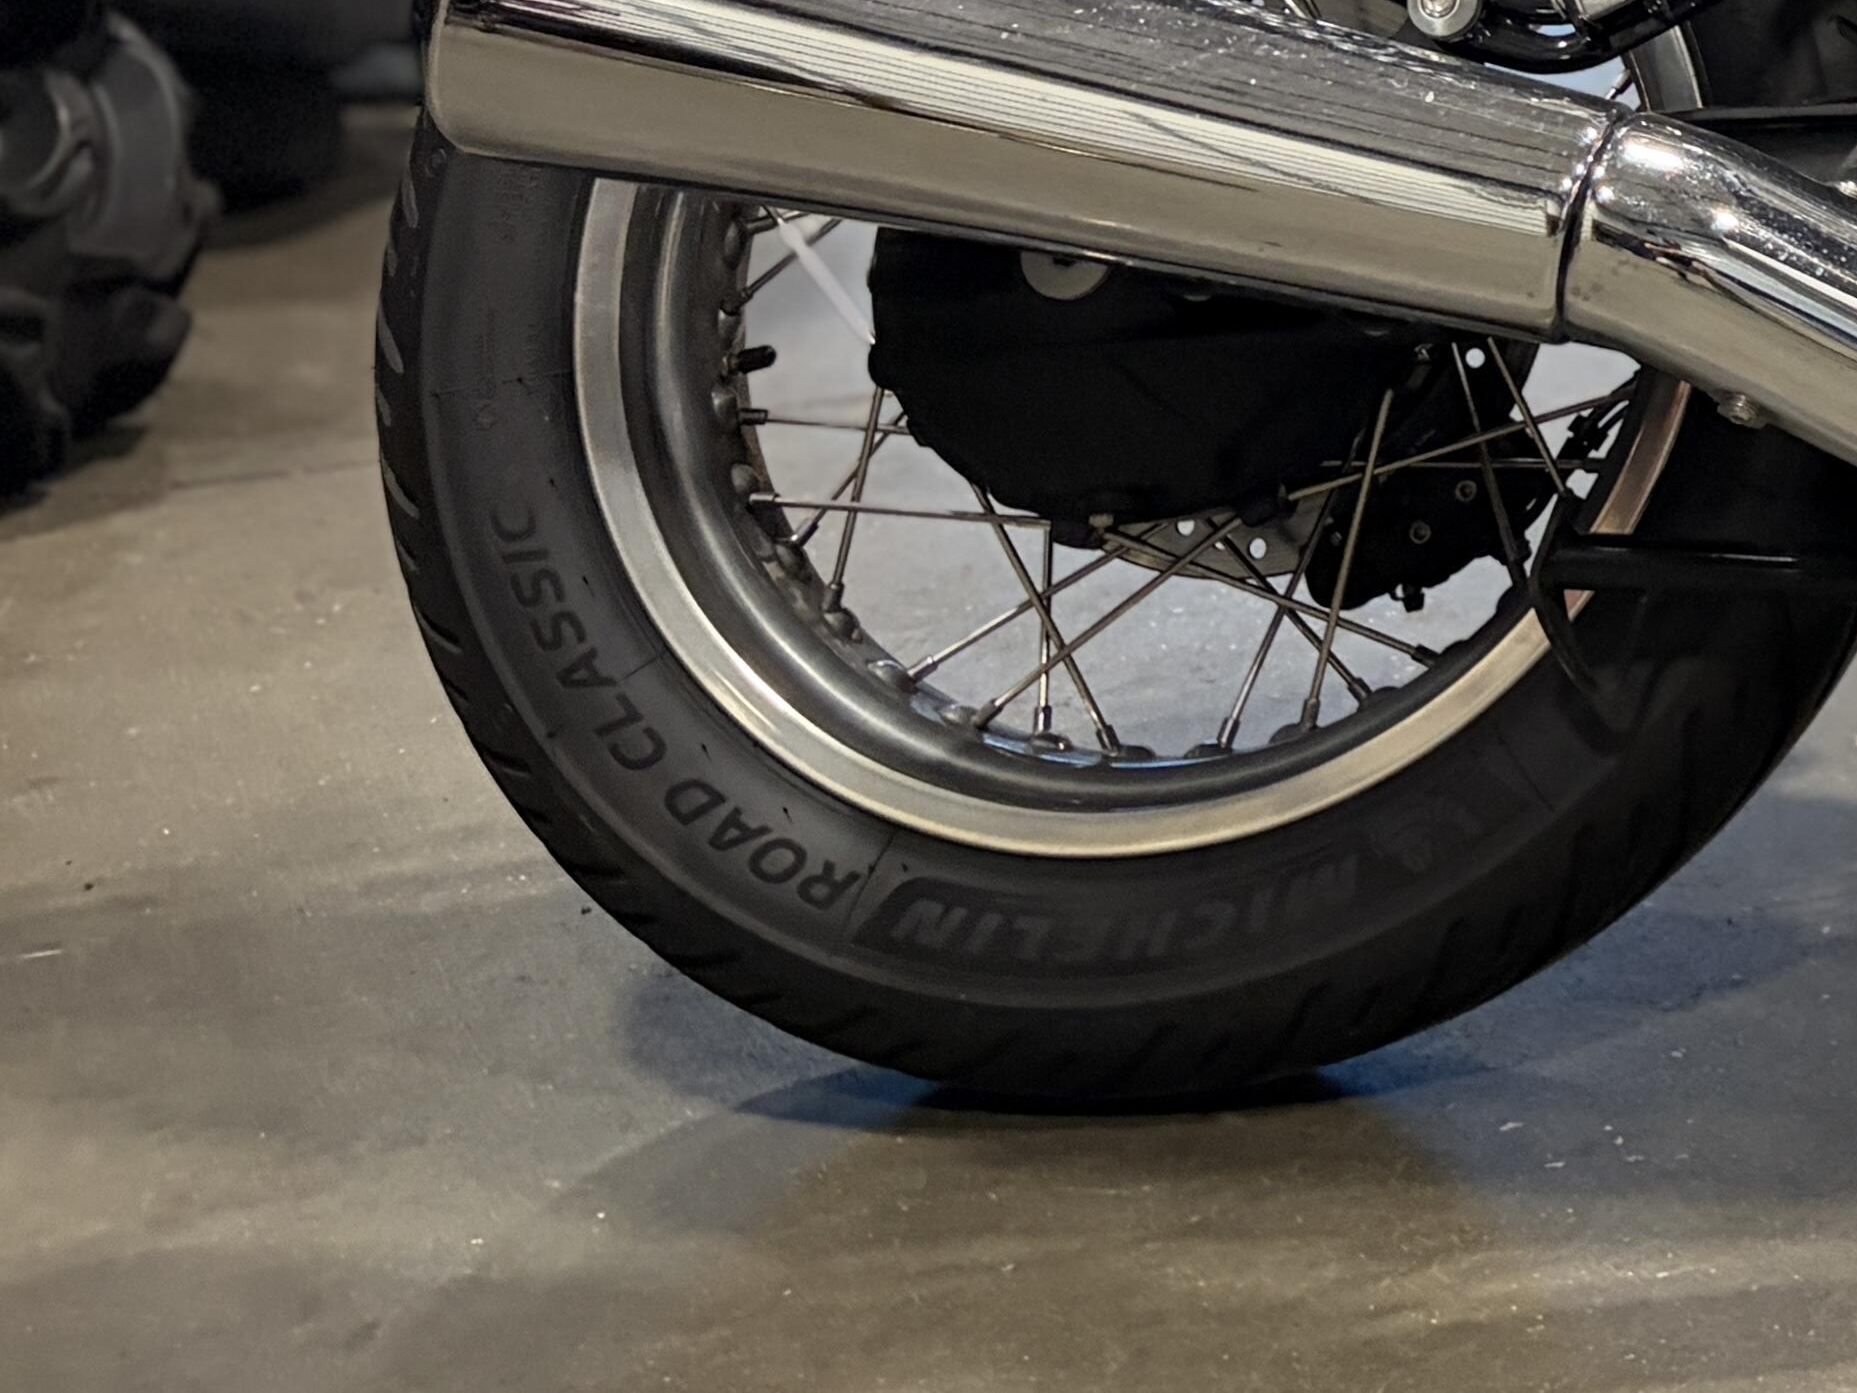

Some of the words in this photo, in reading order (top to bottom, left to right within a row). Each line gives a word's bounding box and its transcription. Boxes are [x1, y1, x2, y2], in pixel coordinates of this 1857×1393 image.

[490, 509, 667, 771] CLASSIC
[663, 778, 862, 911] ROAD
[890, 852, 1359, 963] MICHELIN
